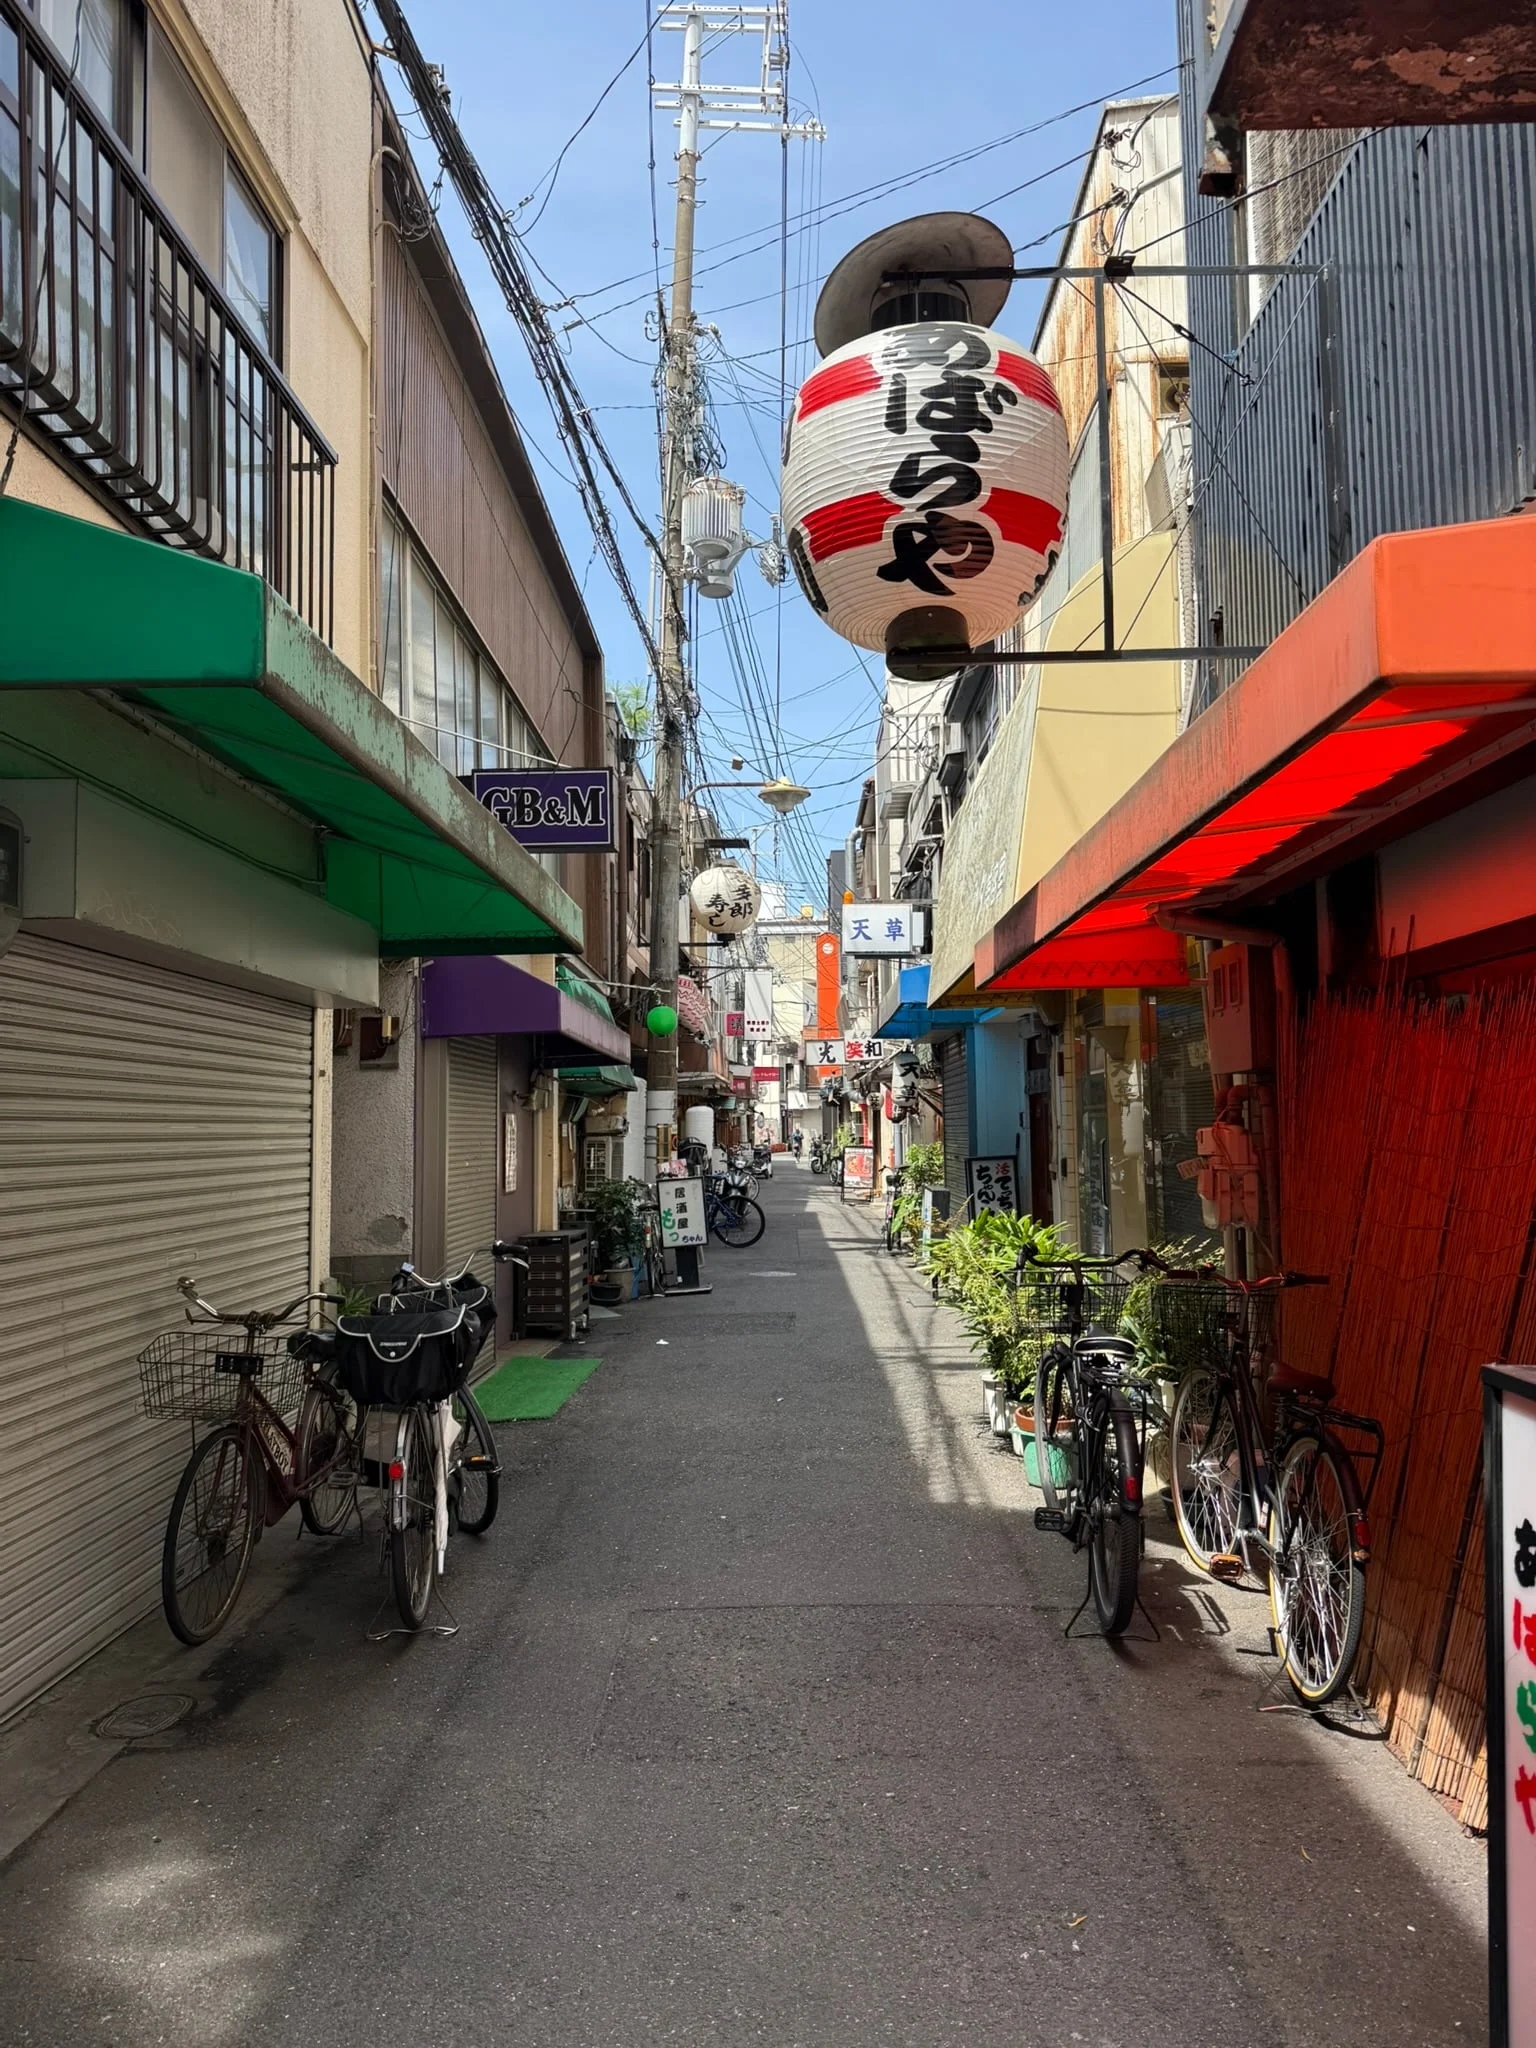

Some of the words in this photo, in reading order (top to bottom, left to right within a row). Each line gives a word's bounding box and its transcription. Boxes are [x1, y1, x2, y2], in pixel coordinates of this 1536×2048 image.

[480, 786, 605, 828] GB&M
[850, 917, 905, 942] 天草
[818, 1040, 837, 1064] 光
[846, 1040, 882, 1059] 笑和
[674, 1187, 689, 1230] 居酒屋
